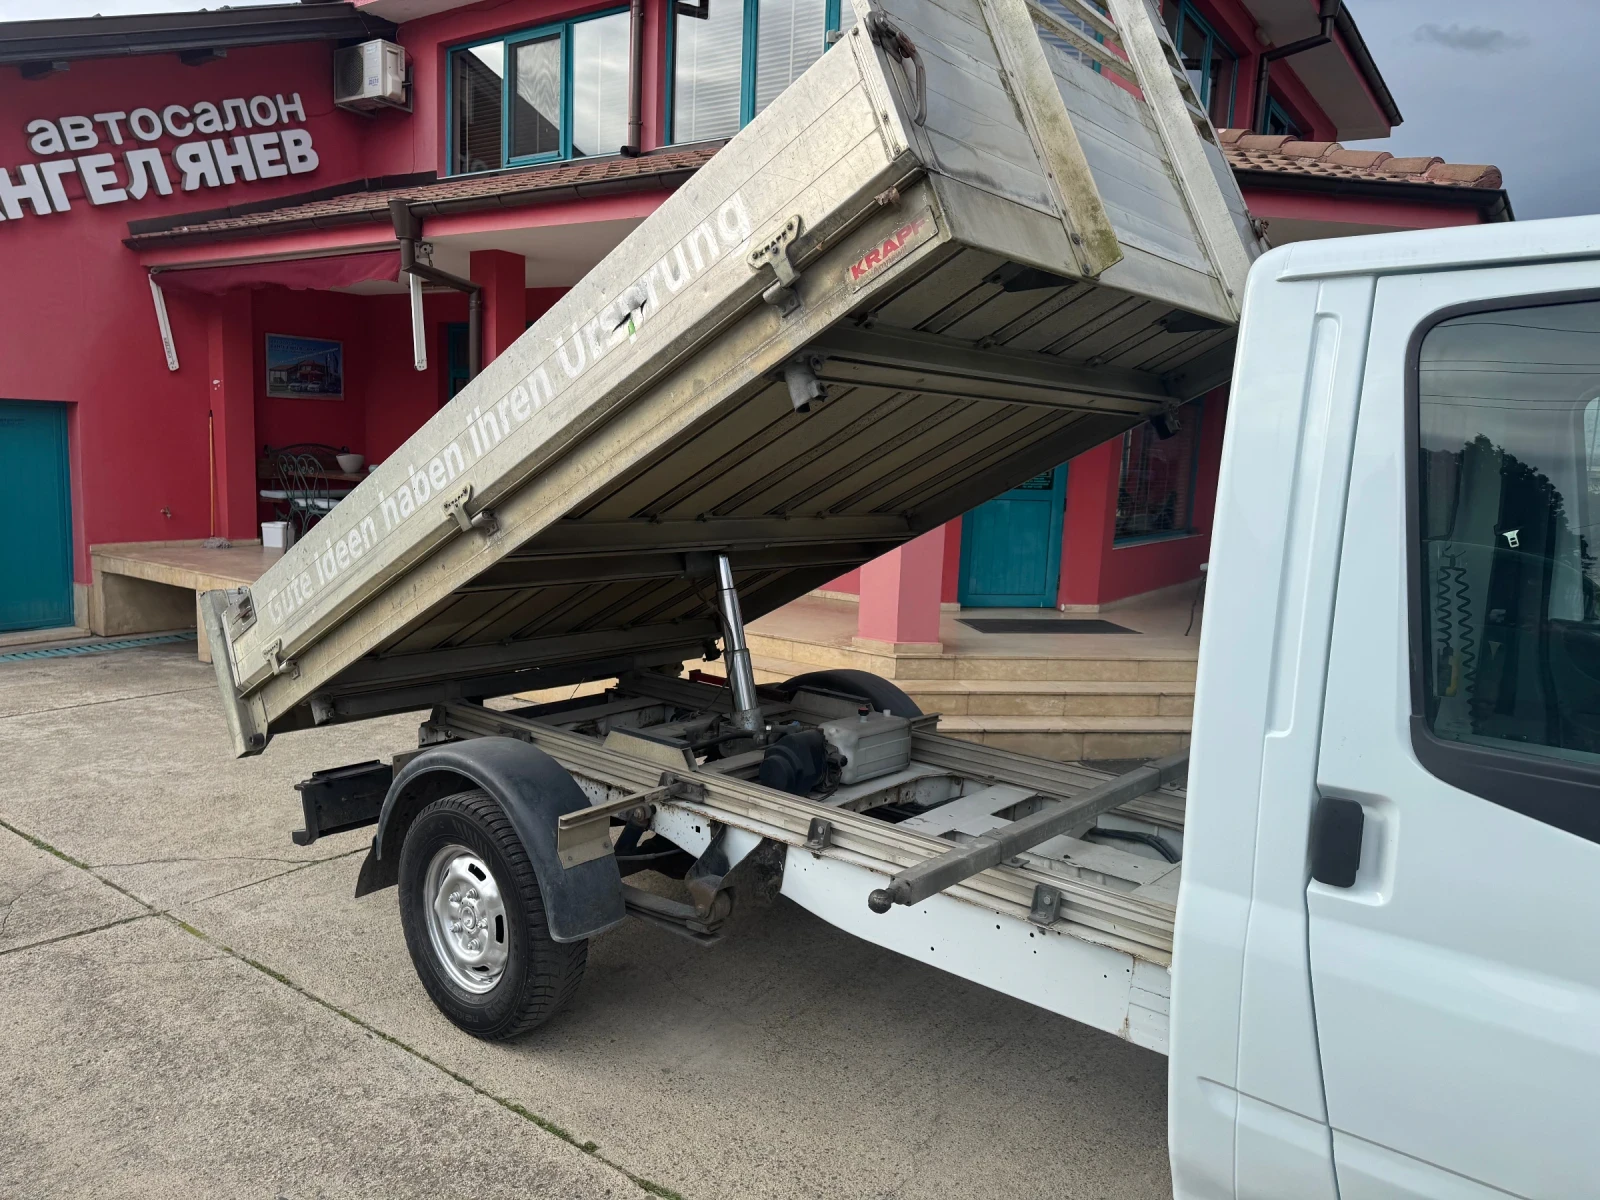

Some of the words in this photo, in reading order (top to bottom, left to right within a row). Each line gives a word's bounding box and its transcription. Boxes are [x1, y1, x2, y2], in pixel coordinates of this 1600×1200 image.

[26, 92, 307, 155] автосалон
[0, 148, 173, 222] НГЕЛ
[173, 129, 320, 192] ЯНЕВ
[851, 216, 926, 281] KRAPF
[266, 575, 314, 625] Gute
[377, 443, 466, 532] haben
[466, 366, 554, 460] ihren
